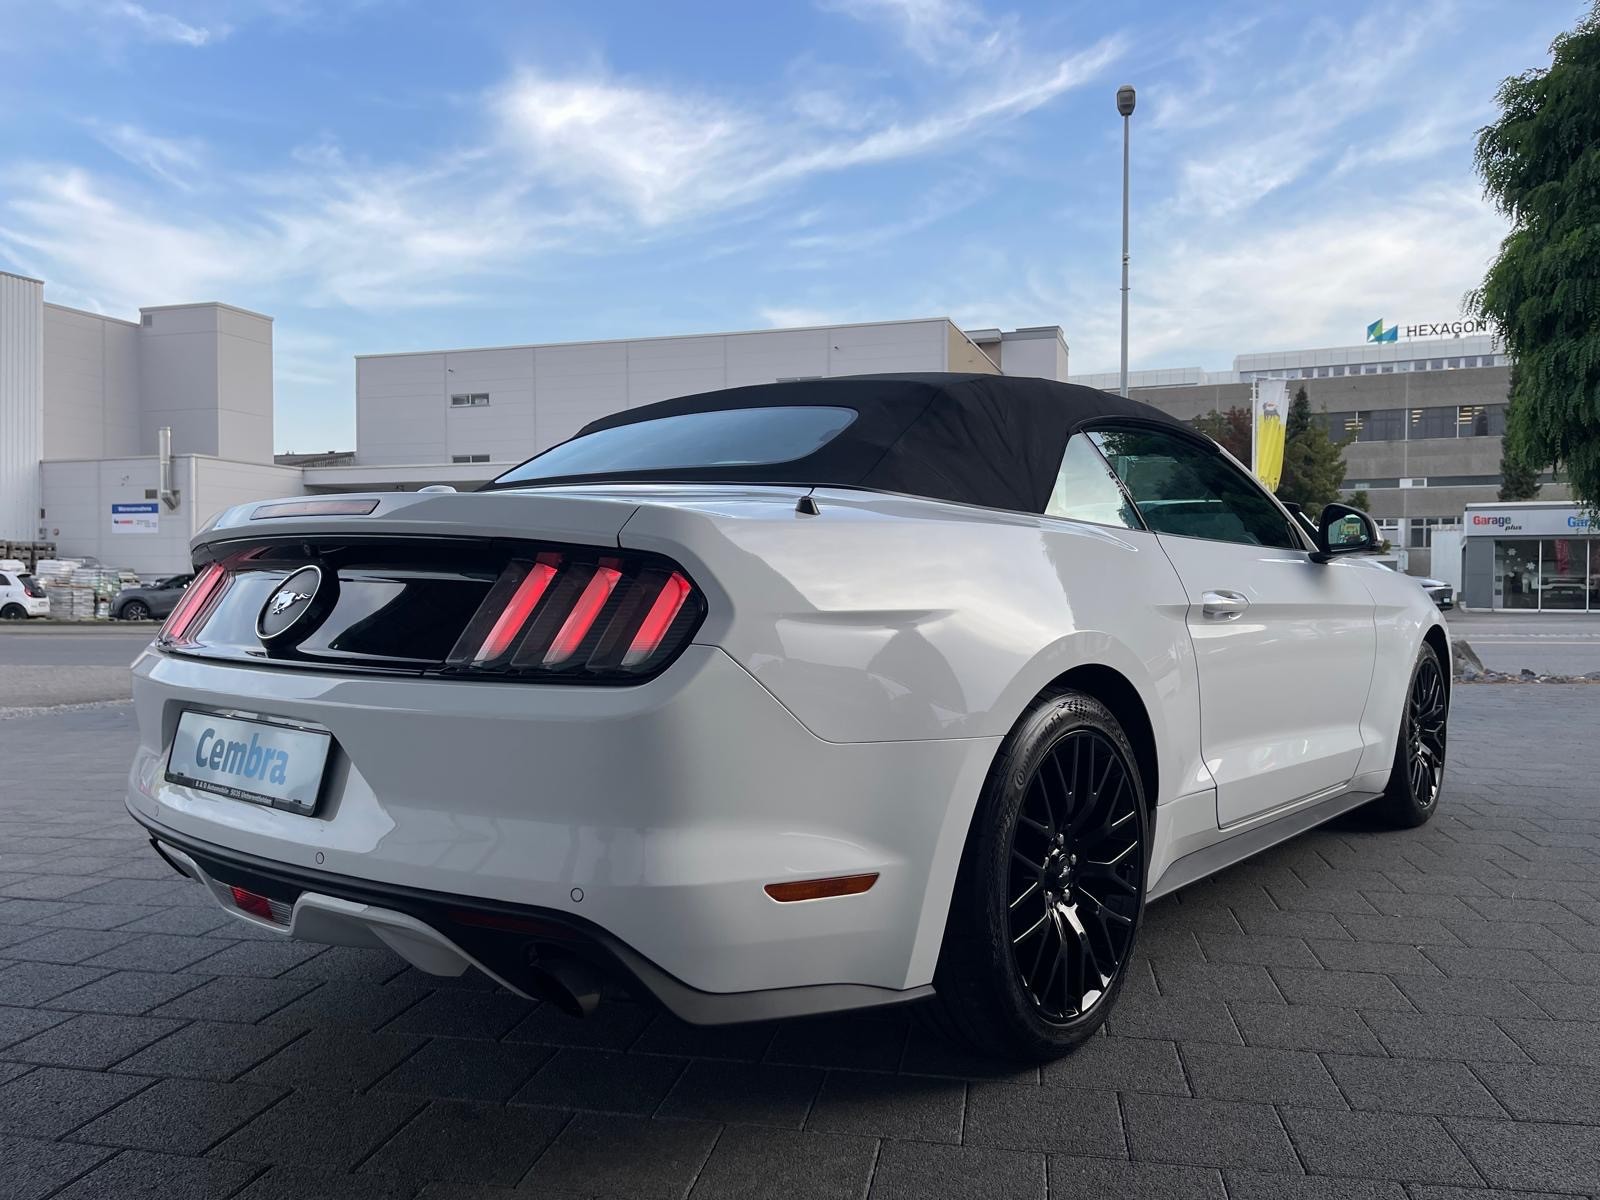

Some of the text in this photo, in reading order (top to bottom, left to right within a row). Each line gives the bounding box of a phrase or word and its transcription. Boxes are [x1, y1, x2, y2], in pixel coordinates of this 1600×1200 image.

[1407, 320, 1486, 337] HEXAGON
[1473, 516, 1511, 527] Garage
[1504, 523, 1522, 532] plus
[196, 728, 289, 785] Cembra
